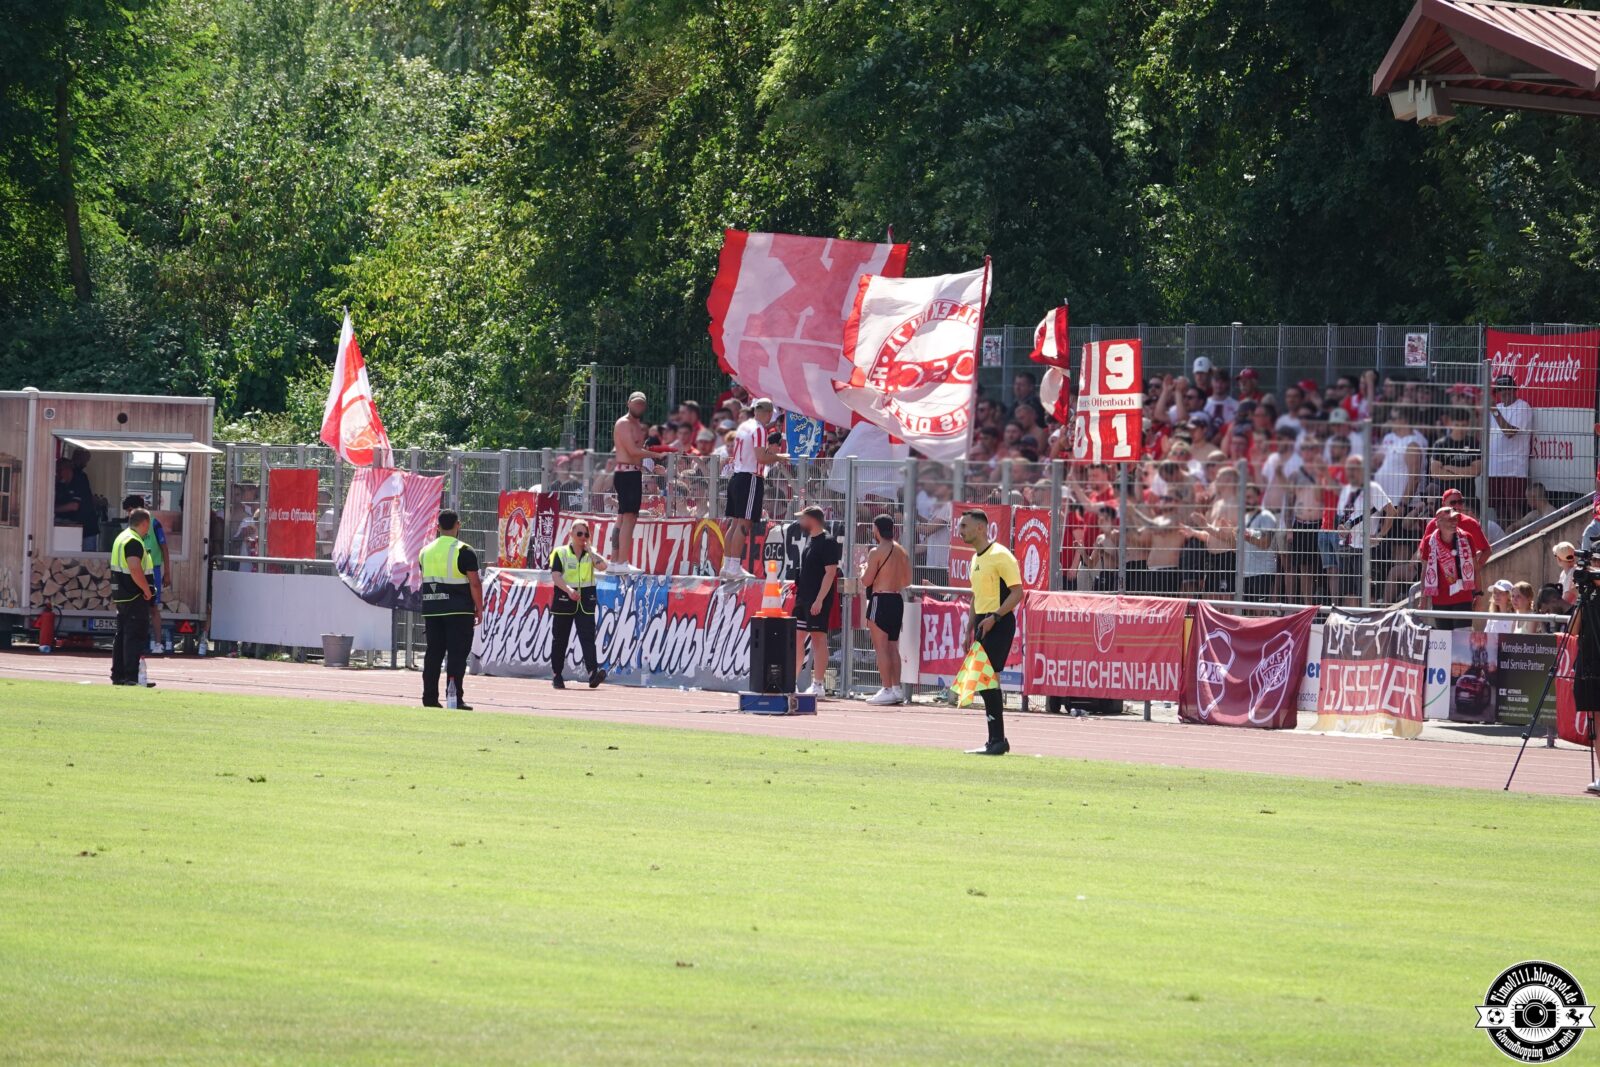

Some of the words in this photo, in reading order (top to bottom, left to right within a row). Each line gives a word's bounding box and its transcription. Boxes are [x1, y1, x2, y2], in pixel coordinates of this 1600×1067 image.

[1091, 396, 1135, 408] Offenbach
[764, 542, 784, 560] O.F.C.
[1047, 607, 1091, 623] KICKERS
[1118, 608, 1173, 626] SUPPORT
[1501, 641, 1535, 655] Mercedes-Benz
[1032, 653, 1180, 692] DREIEICHENHAIN
[1499, 658, 1509, 670] und
[1510, 658, 1546, 671] Service-Partner
